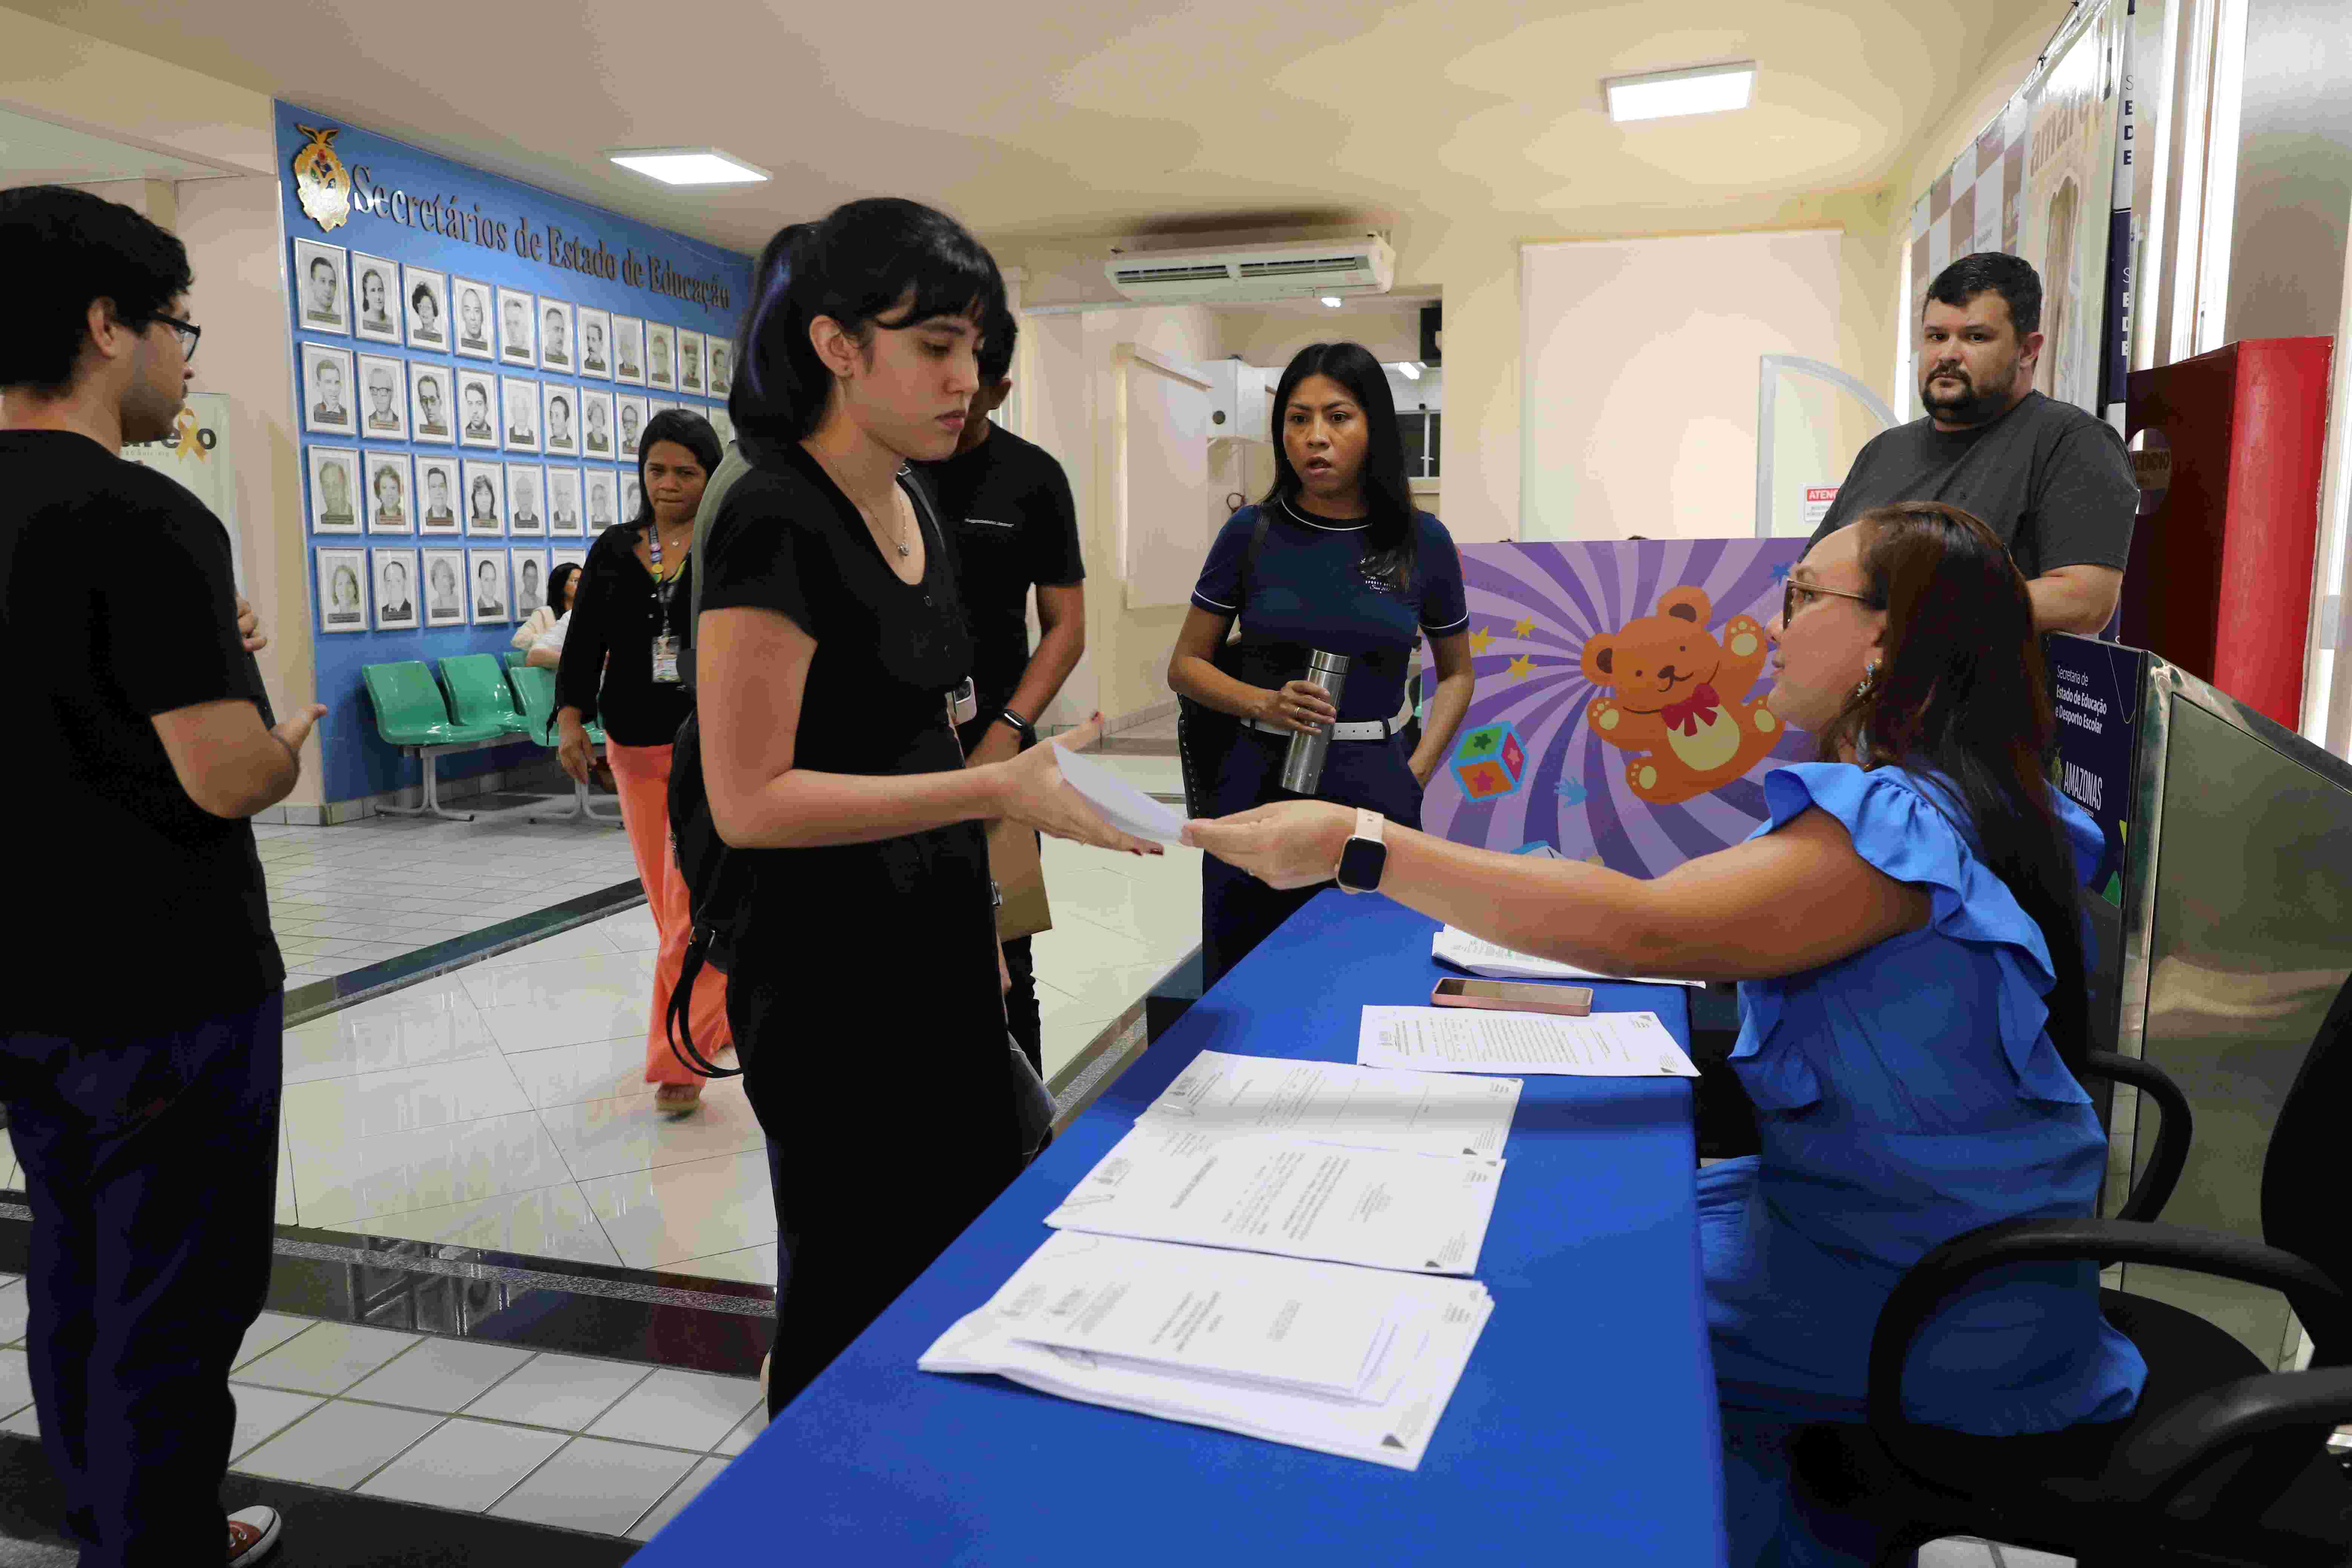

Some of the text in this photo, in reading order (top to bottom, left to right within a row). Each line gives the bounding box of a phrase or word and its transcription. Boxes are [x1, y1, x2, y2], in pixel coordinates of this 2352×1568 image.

[352, 164, 730, 314] Secretários de Estado de Educação
[2056, 665, 2089, 686] Secretaria de
[2056, 684, 2107, 717] Estado de Educação
[2055, 704, 2102, 734] e Desporto Escolar
[2064, 761, 2102, 811] AMAZONAS
